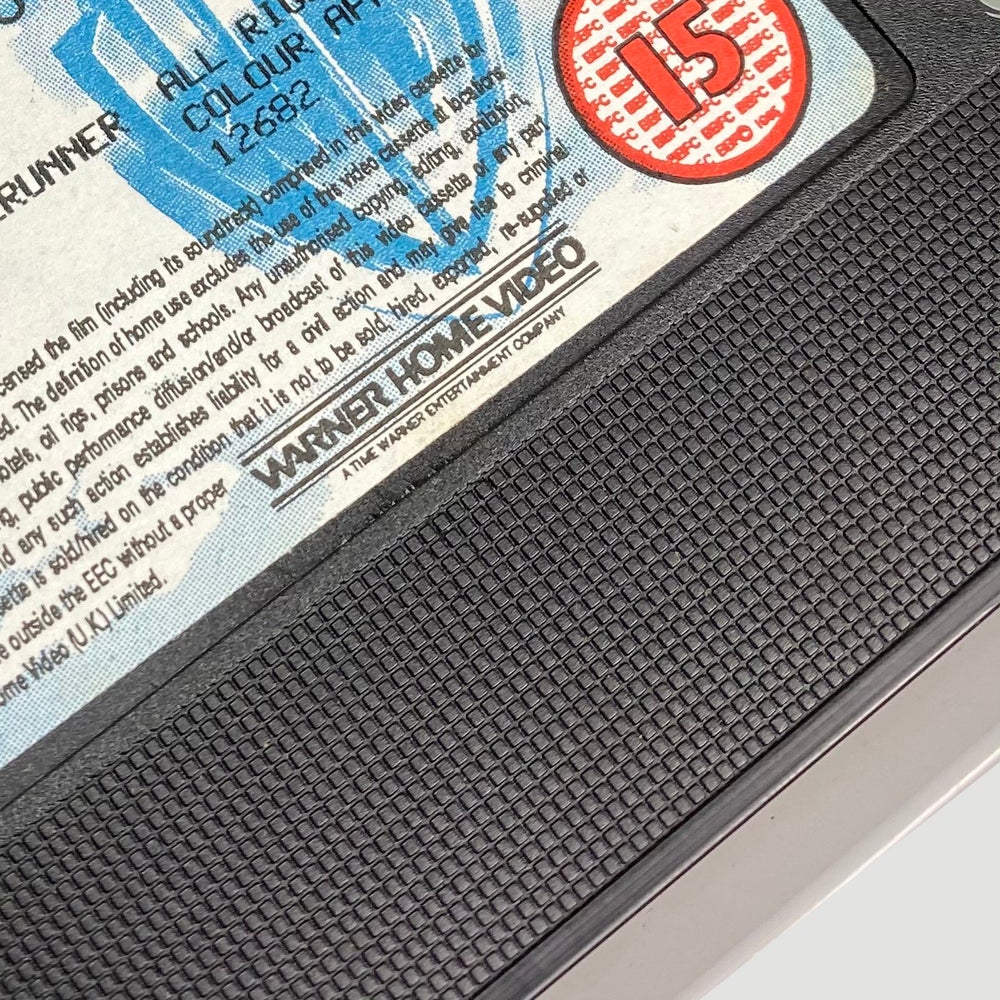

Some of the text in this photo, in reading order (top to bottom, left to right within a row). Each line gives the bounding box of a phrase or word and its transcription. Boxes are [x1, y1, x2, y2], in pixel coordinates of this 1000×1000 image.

[42, 334, 71, 361] the
[66, 315, 99, 342] film
[94, 268, 167, 327] (including
[158, 254, 184, 276] its
[258, 143, 332, 206] comprised
[324, 137, 349, 157] in
[341, 117, 374, 145] this
[368, 92, 411, 125] video
[408, 54, 466, 100] cassette
[459, 38, 486, 61] for
[154, 47, 229, 102] ALL
[180, 30, 315, 134] COLOUR
[210, 78, 321, 167] 12682
[11, 395, 47, 422] The
[45, 349, 111, 403] definition
[107, 331, 127, 357] of
[119, 308, 167, 346] home
[161, 289, 193, 318] use
[189, 248, 251, 298] excludes
[245, 229, 276, 256] the
[298, 194, 317, 219] of
[311, 181, 344, 208] this
[337, 154, 380, 190] video
[376, 116, 436, 163] cassette
[16, 524, 47, 555] any
[46, 495, 85, 532] such
[85, 463, 132, 504] action
[132, 405, 210, 469] establishes
[205, 365, 262, 411] liability
[257, 349, 283, 373] for
[284, 339, 301, 356] a
[300, 311, 331, 344] civil
[330, 283, 378, 322] action
[375, 257, 406, 290] and
[494, 180, 517, 200] to
[17, 469, 64, 515] public
[63, 404, 152, 481] performance
[253, 272, 329, 333] broadcast
[328, 256, 347, 282] of
[344, 241, 375, 268] this
[374, 213, 415, 247] video
[414, 171, 473, 220] cassette
[516, 113, 551, 149] part
[25, 569, 48, 589] is
[47, 510, 118, 576] sold/hired
[117, 499, 141, 524] on
[137, 480, 166, 507] the
[165, 432, 233, 487] condition
[228, 406, 264, 439] that
[255, 396, 277, 417] it
[268, 388, 291, 408] is
[288, 365, 319, 396] not
[313, 356, 335, 376] to
[329, 340, 357, 363] be
[353, 310, 396, 347] sold,
[385, 281, 436, 321] hired,
[430, 235, 499, 291] exported,
[571, 166, 591, 188] or
[38, 423, 60, 450] oil
[59, 406, 97, 435] rigs,
[92, 364, 147, 415] prisons
[146, 337, 177, 372] and
[176, 302, 237, 349] schools.
[233, 277, 267, 308] Any
[351, 176, 414, 222] copying,
[409, 140, 464, 181] editing,
[248, 234, 586, 491] WARNER HOME VIDEO
[341, 305, 566, 480] A TIME WARNER ENTERTAINMENT COMPANY
[7, 603, 63, 651] outside
[57, 584, 88, 612] the
[80, 556, 118, 594] EEC
[115, 519, 173, 569] without
[168, 513, 184, 531] a
[179, 477, 228, 526] proper
[21, 642, 70, 681] Video
[104, 567, 163, 621] Limited.
